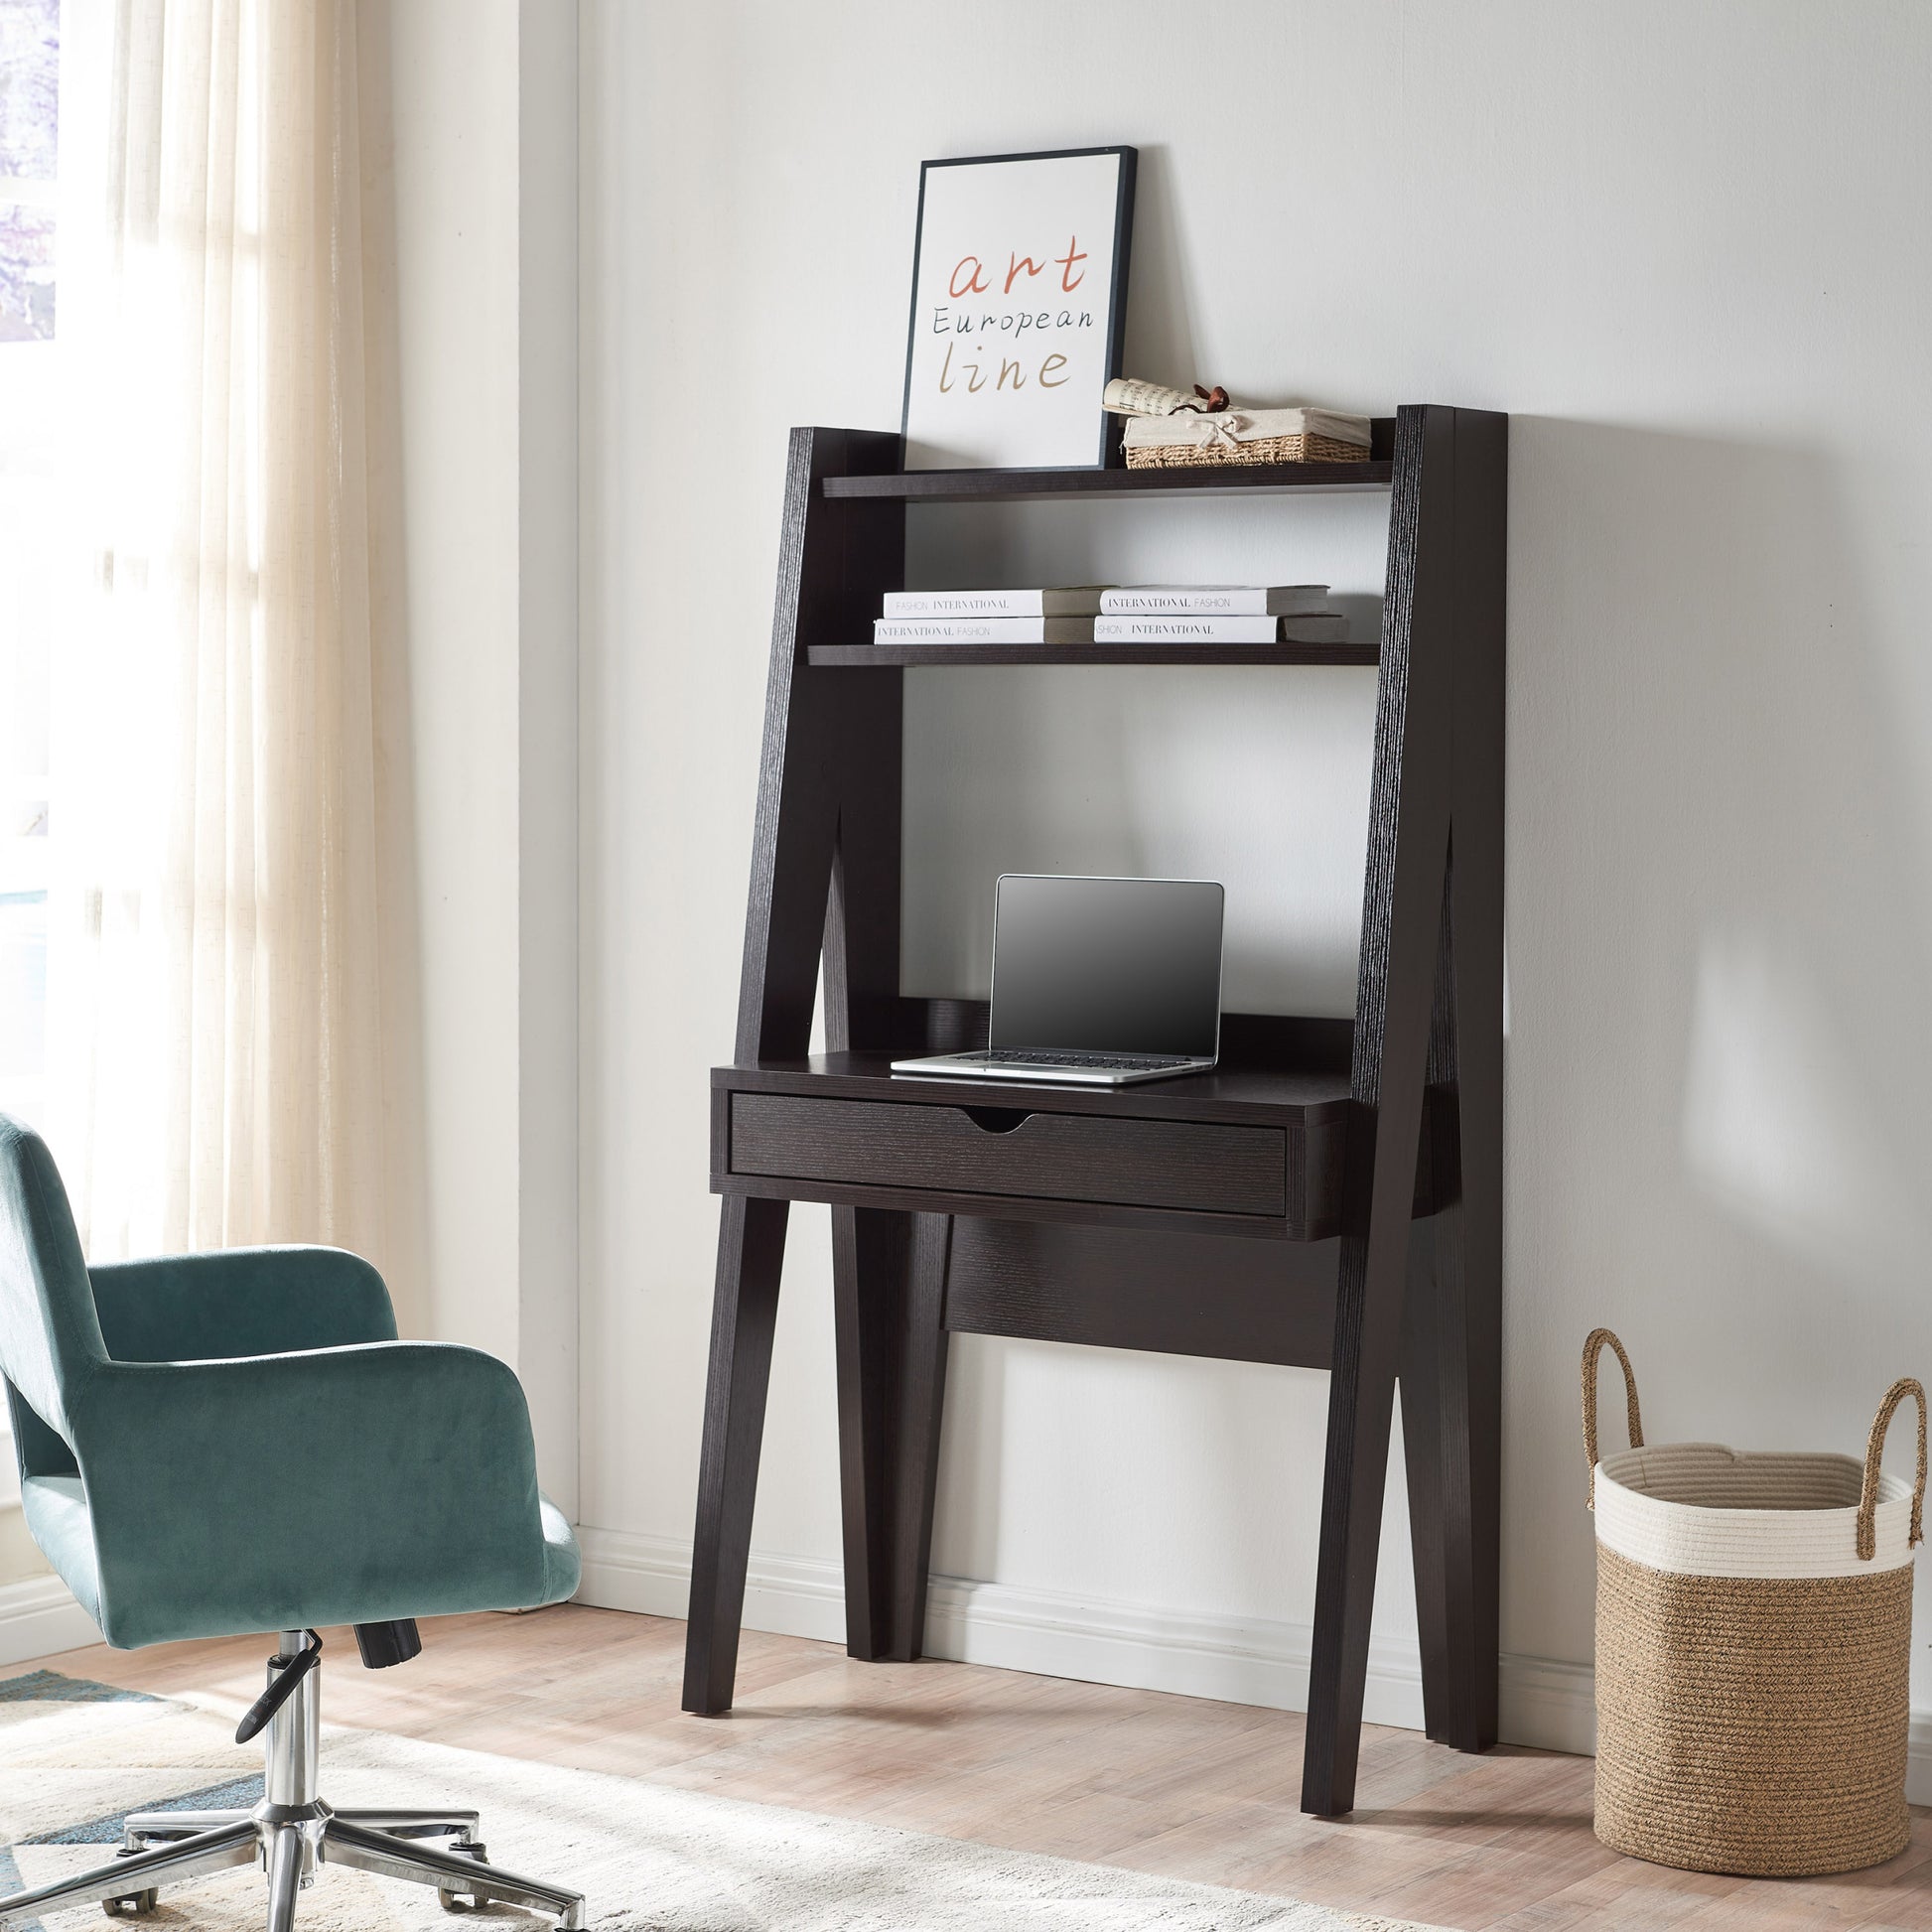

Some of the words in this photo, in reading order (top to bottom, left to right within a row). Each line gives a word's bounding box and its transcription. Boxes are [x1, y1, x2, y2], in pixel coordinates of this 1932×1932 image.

[949, 235, 1088, 298] art
[933, 306, 1093, 338] European
[939, 342, 1071, 393] line
[896, 602, 928, 611] FASHION
[933, 600, 1010, 610] INTERNATIONAL
[1108, 598, 1191, 608] INTERNATIONAL
[1194, 598, 1231, 608] FASHION
[878, 626, 954, 636] INTERNATIONAL
[957, 626, 991, 636] FASHION
[1131, 624, 1214, 635] INTERNATIONAL
